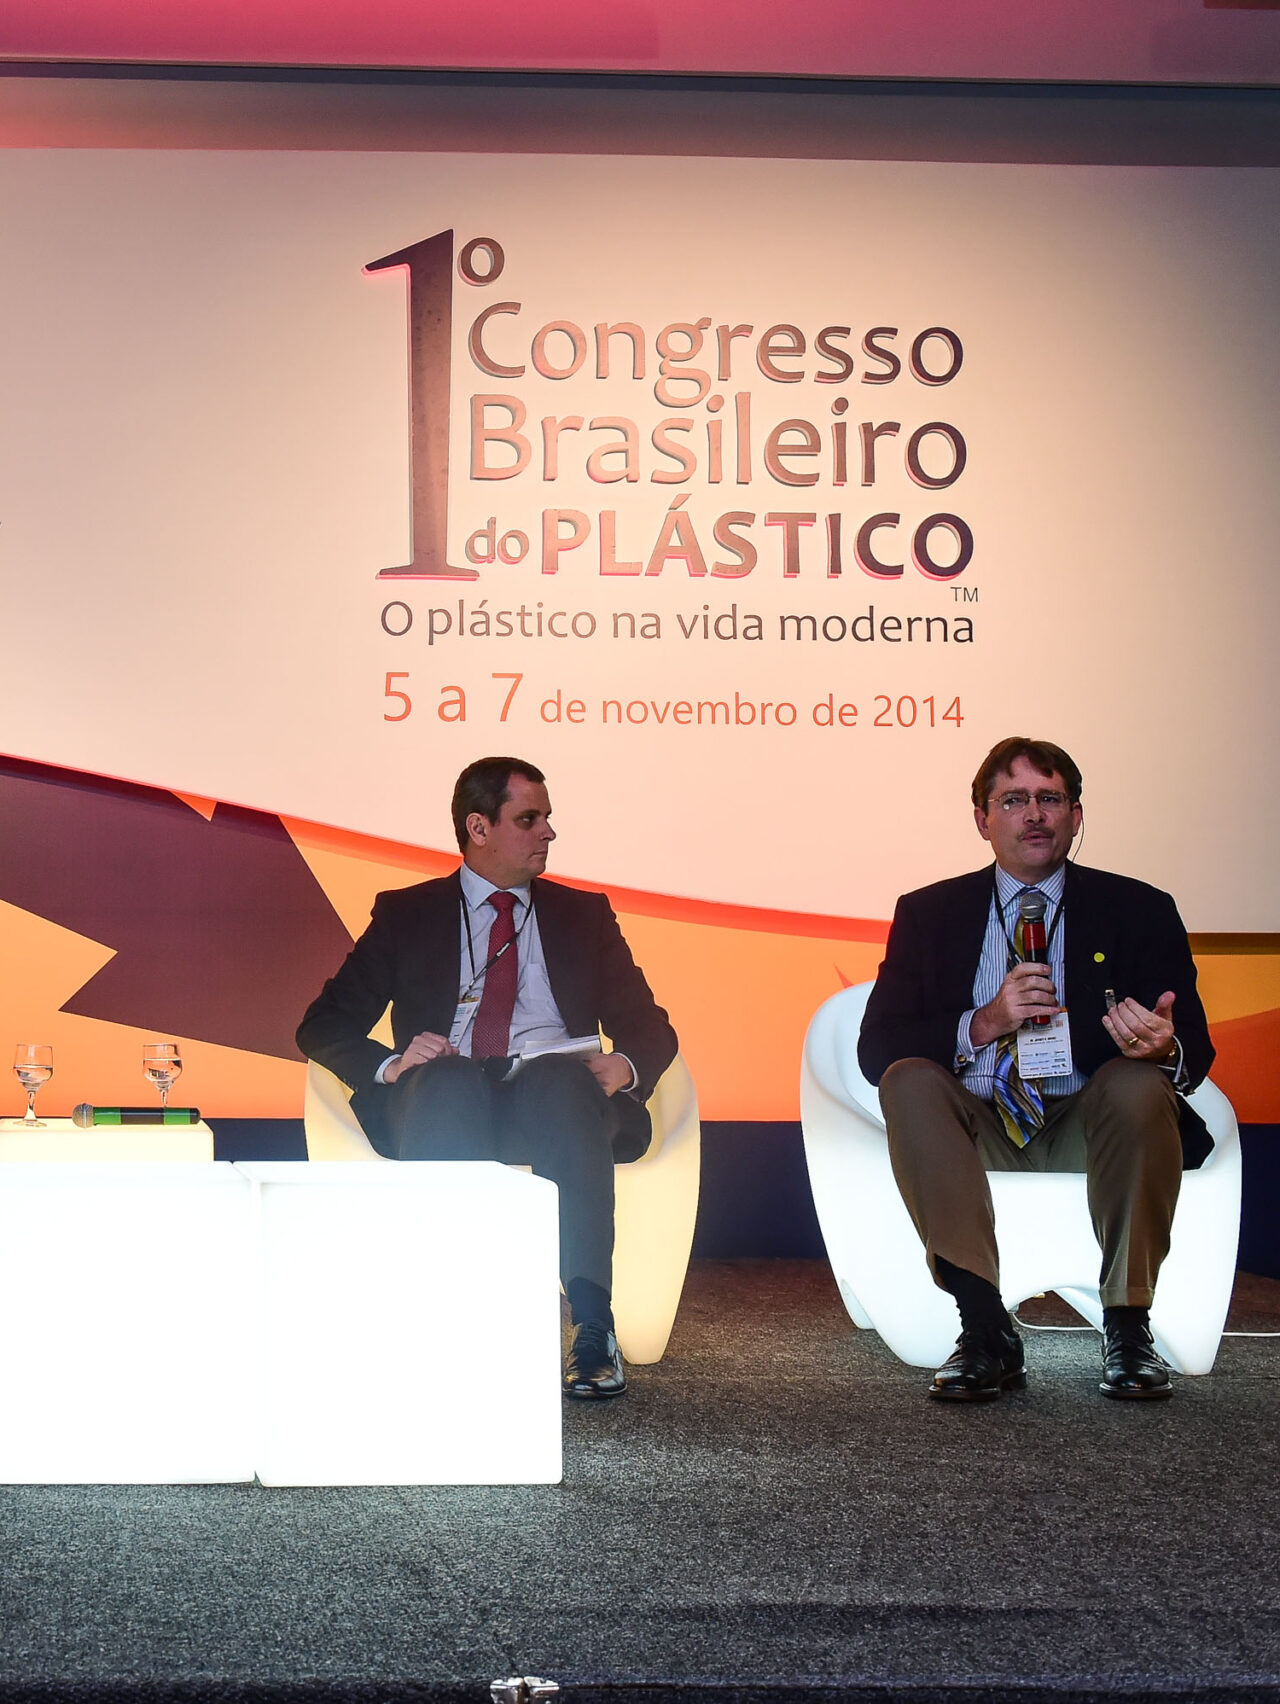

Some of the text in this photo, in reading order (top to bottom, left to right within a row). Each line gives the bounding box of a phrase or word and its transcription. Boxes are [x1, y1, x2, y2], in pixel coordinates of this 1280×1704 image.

[468, 301, 965, 408] Congresso
[469, 392, 968, 490] Brasileiro
[465, 493, 975, 581] do PLÁSTICO
[380, 599, 975, 646] O plástico na vida moderna
[950, 586, 979, 603] TM
[383, 671, 965, 728] 5 a 7 de novembro de 2014
